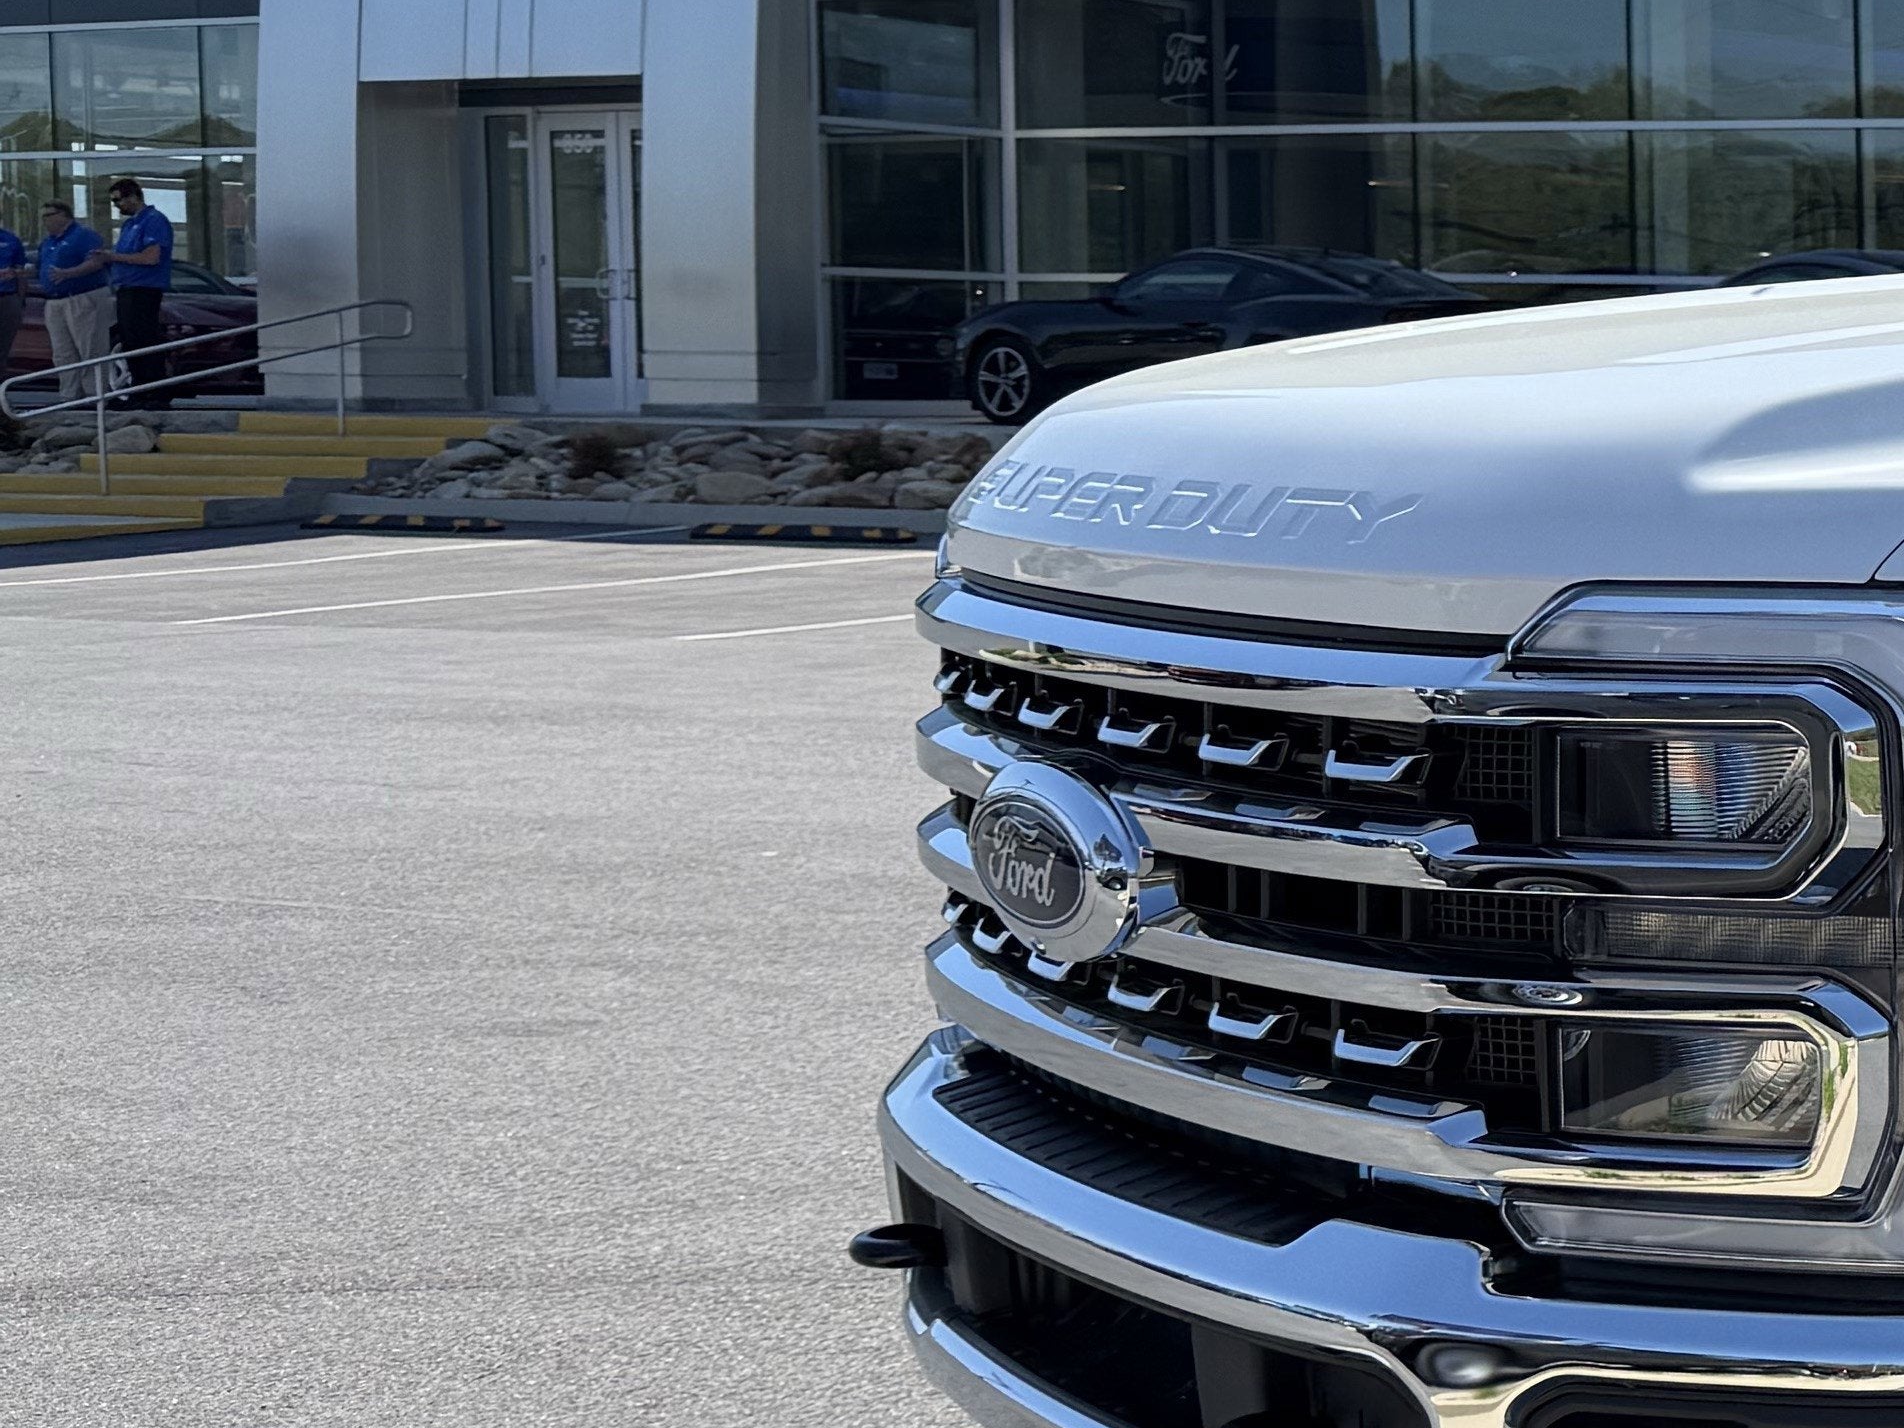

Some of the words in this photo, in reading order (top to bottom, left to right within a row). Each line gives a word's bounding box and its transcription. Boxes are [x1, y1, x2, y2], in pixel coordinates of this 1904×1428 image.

[967, 458, 1156, 526] SUPER
[1146, 478, 1424, 545] DUTY
[987, 815, 1056, 907] Ford
